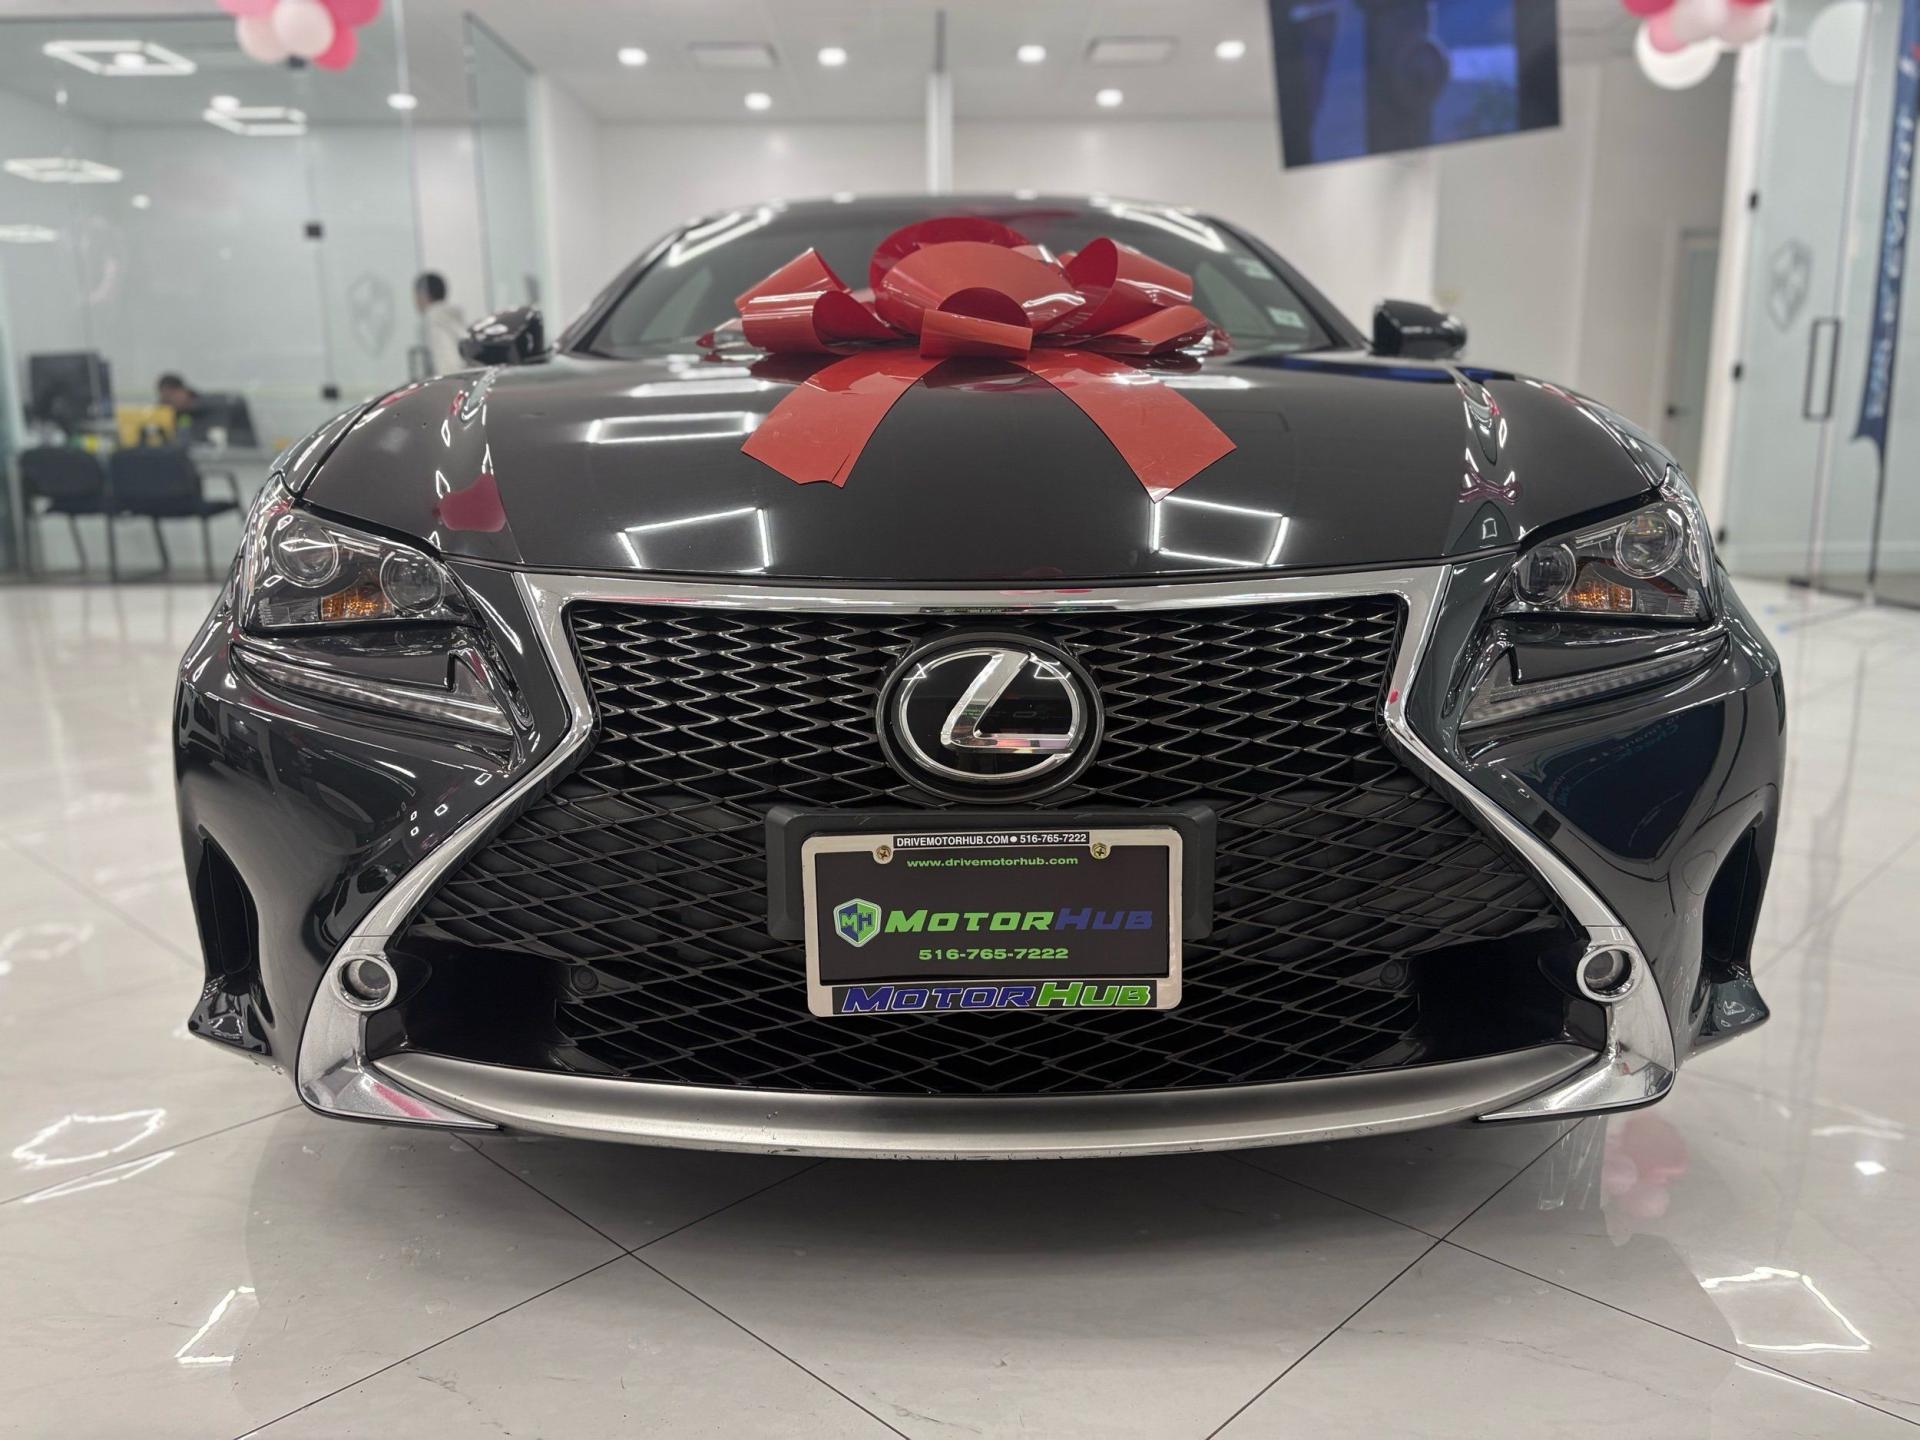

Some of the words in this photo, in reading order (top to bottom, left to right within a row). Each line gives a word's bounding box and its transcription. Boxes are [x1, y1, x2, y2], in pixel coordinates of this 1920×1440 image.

[897, 834, 1009, 847] DRIVEMOTORHUB.COM
[1019, 833, 1087, 844] 516-765-7222
[907, 857, 1078, 868] www.drivemotorhub.com
[919, 948, 1069, 961] 516-765-7222
